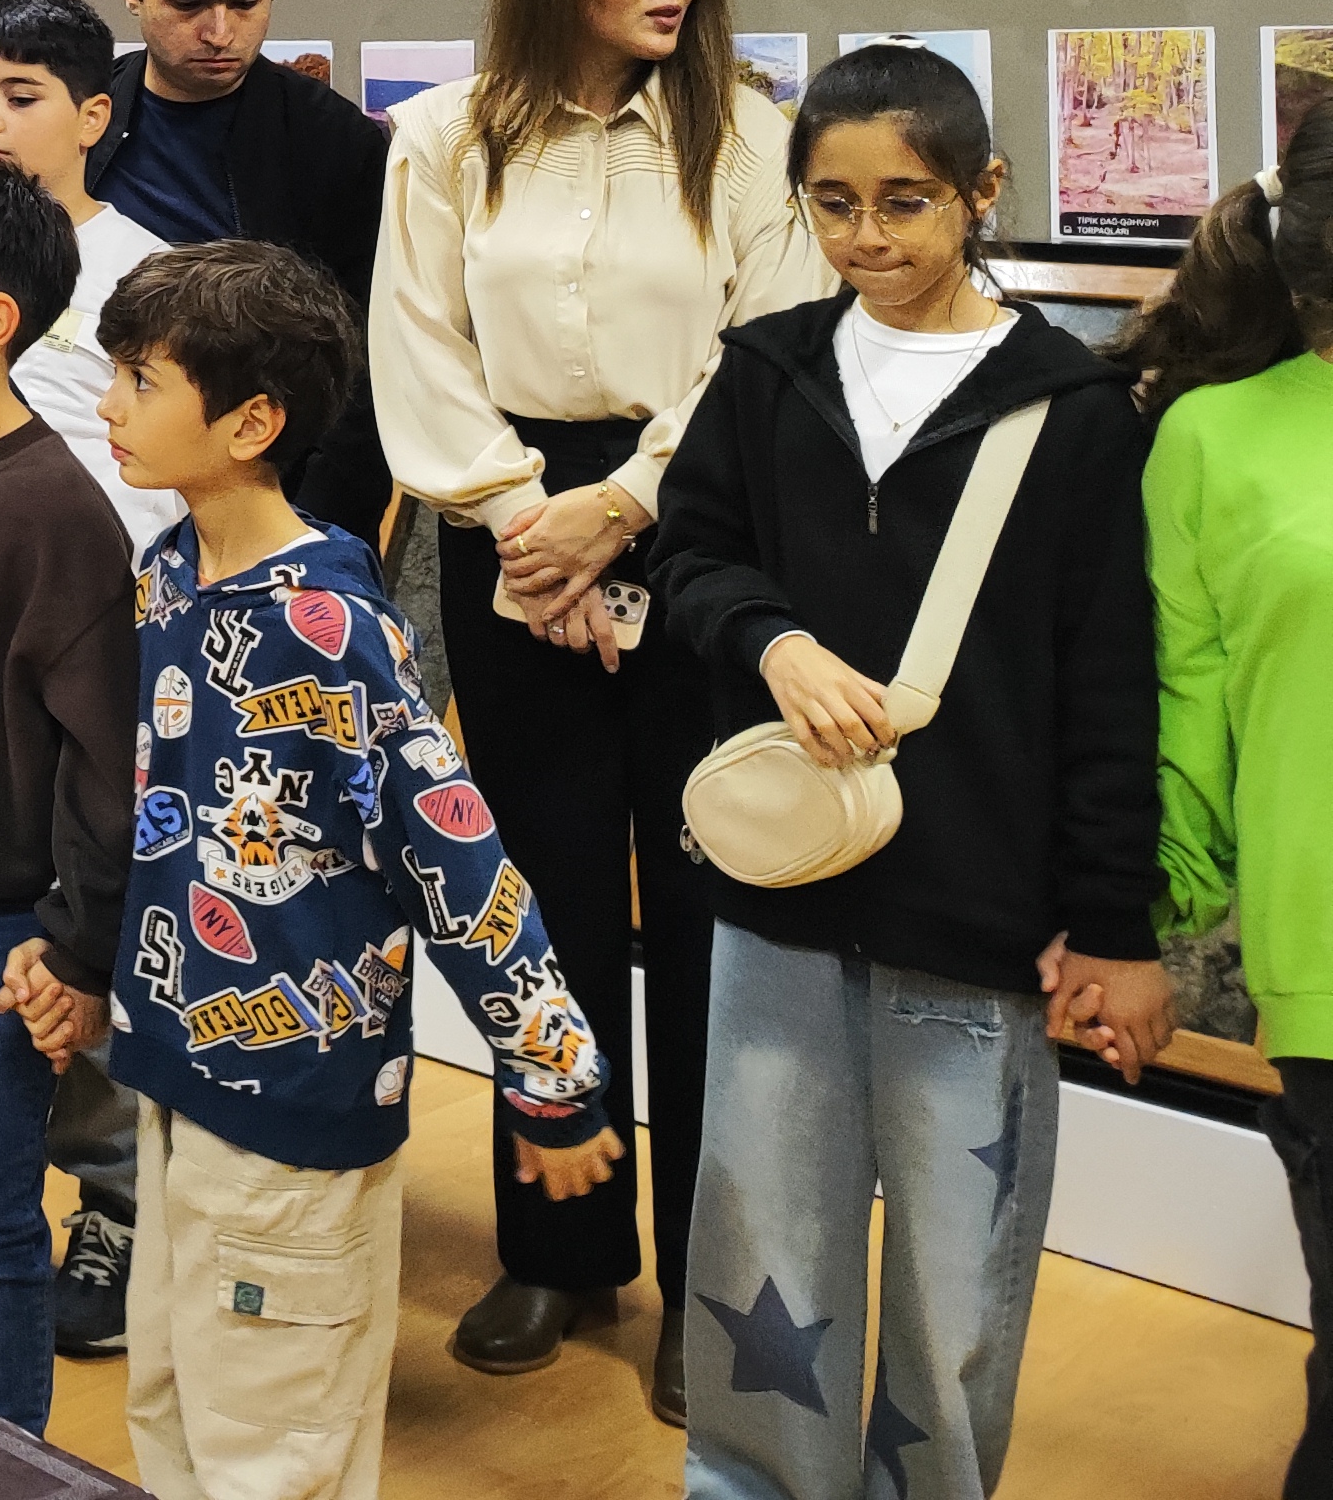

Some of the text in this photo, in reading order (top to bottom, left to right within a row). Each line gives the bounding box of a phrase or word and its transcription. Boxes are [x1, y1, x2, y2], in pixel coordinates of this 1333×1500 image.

[302, 601, 334, 625] NY
[257, 686, 322, 724] TEAM
[449, 801, 476, 826] NY
[231, 870, 296, 897] TIGERS
[200, 906, 234, 937] NY
[251, 996, 301, 1037] GO
